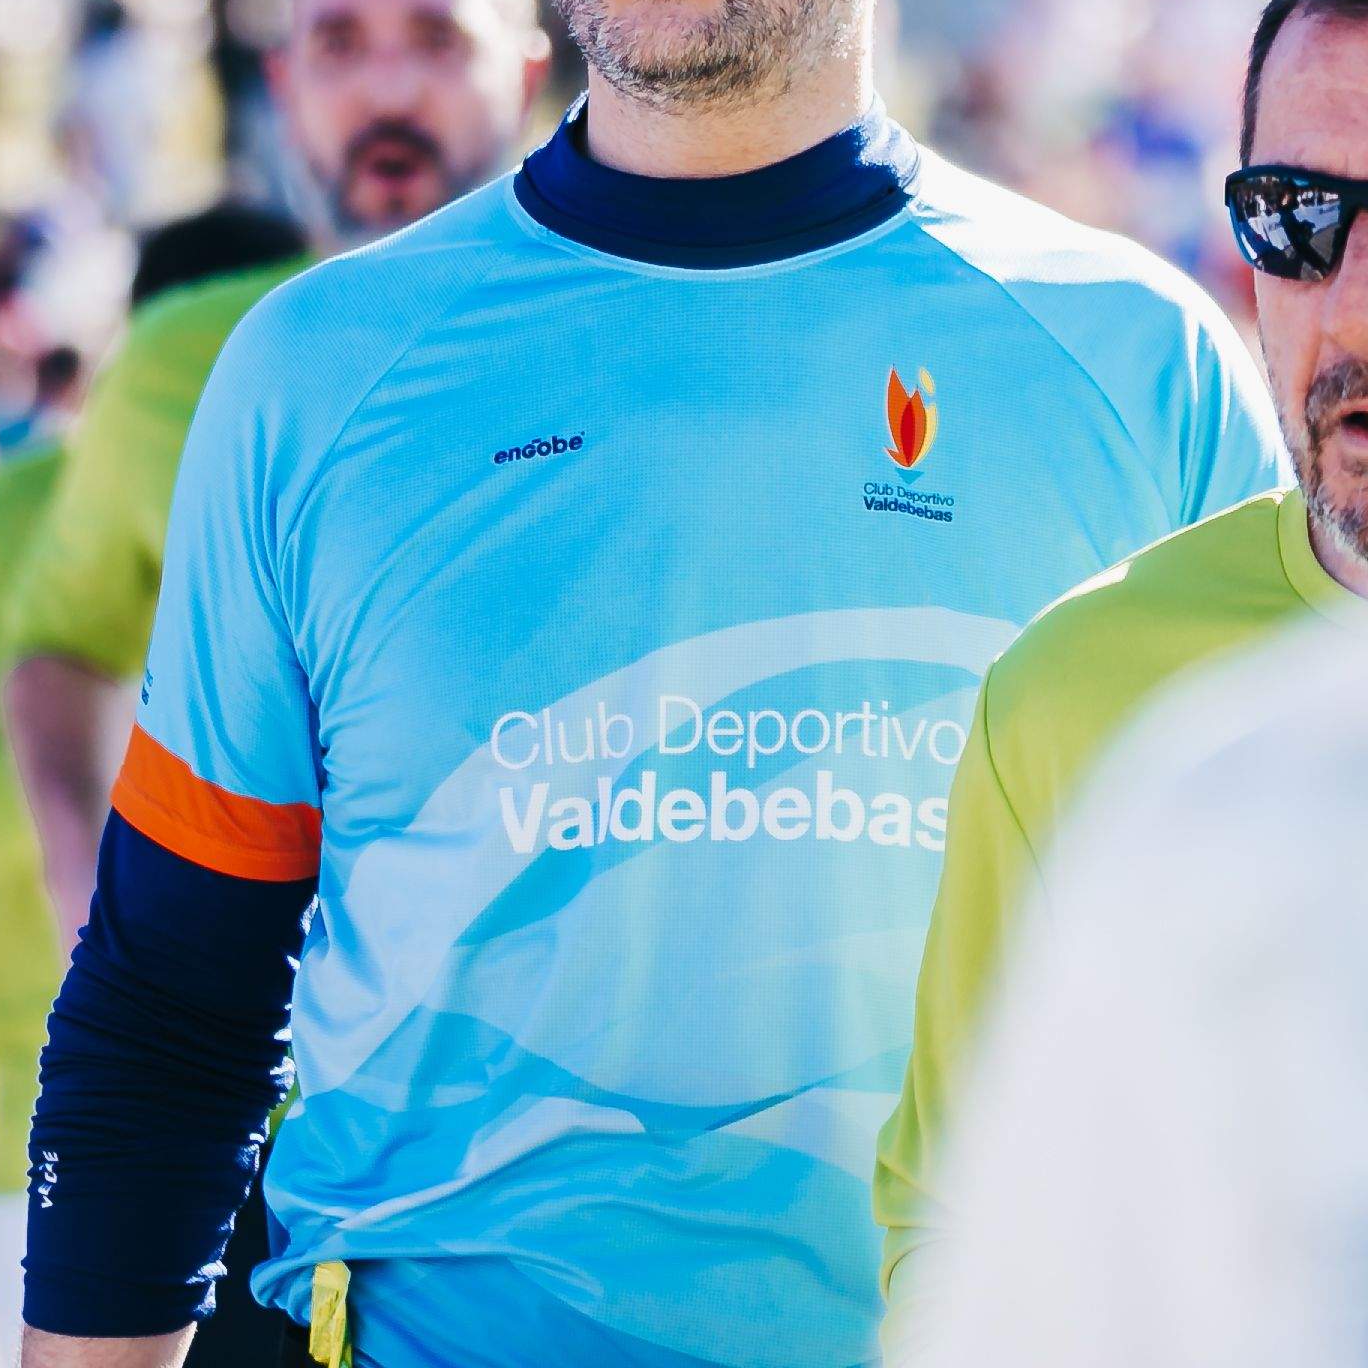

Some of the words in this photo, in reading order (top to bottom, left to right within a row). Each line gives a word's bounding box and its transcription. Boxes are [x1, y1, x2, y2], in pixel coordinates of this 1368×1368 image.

[863, 482, 894, 496] Club
[896, 486, 955, 507] Deportivo
[863, 496, 953, 522] Valdebebas
[490, 701, 635, 770] Club
[658, 695, 966, 769] Deportivo
[498, 770, 949, 854] Valdebebas
